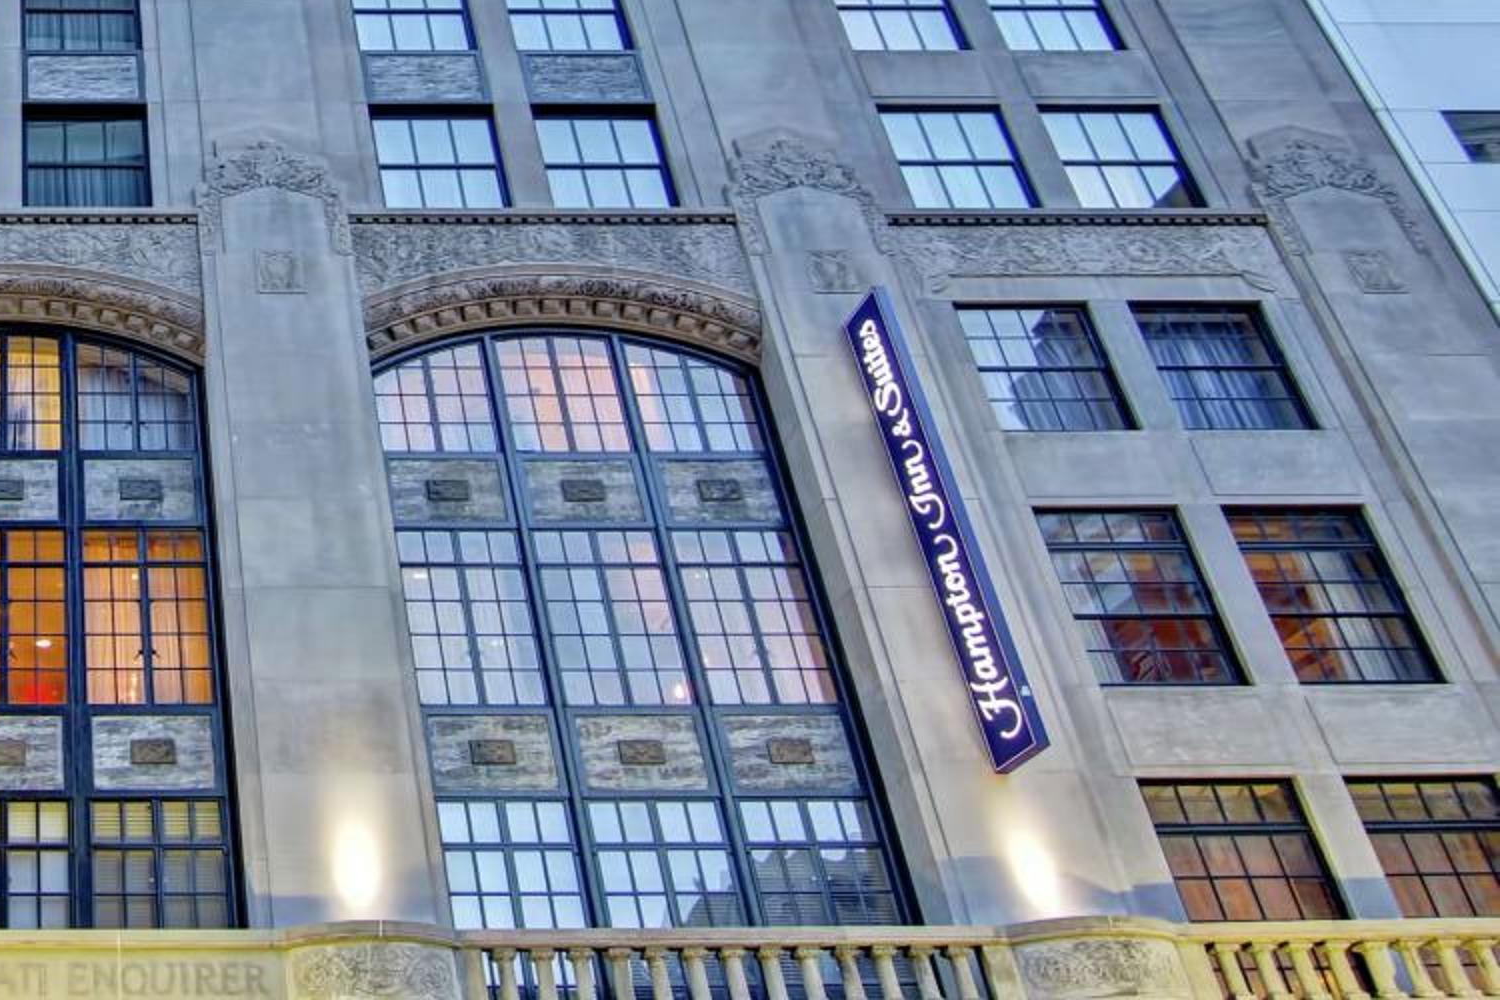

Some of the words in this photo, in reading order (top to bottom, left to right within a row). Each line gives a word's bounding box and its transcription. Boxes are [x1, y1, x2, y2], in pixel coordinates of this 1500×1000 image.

[859, 319, 902, 416] Suites
[892, 407, 912, 436] &
[902, 439, 944, 530] Inn
[933, 534, 1023, 739] Hampton
[67, 960, 269, 997] ENQUIRER
